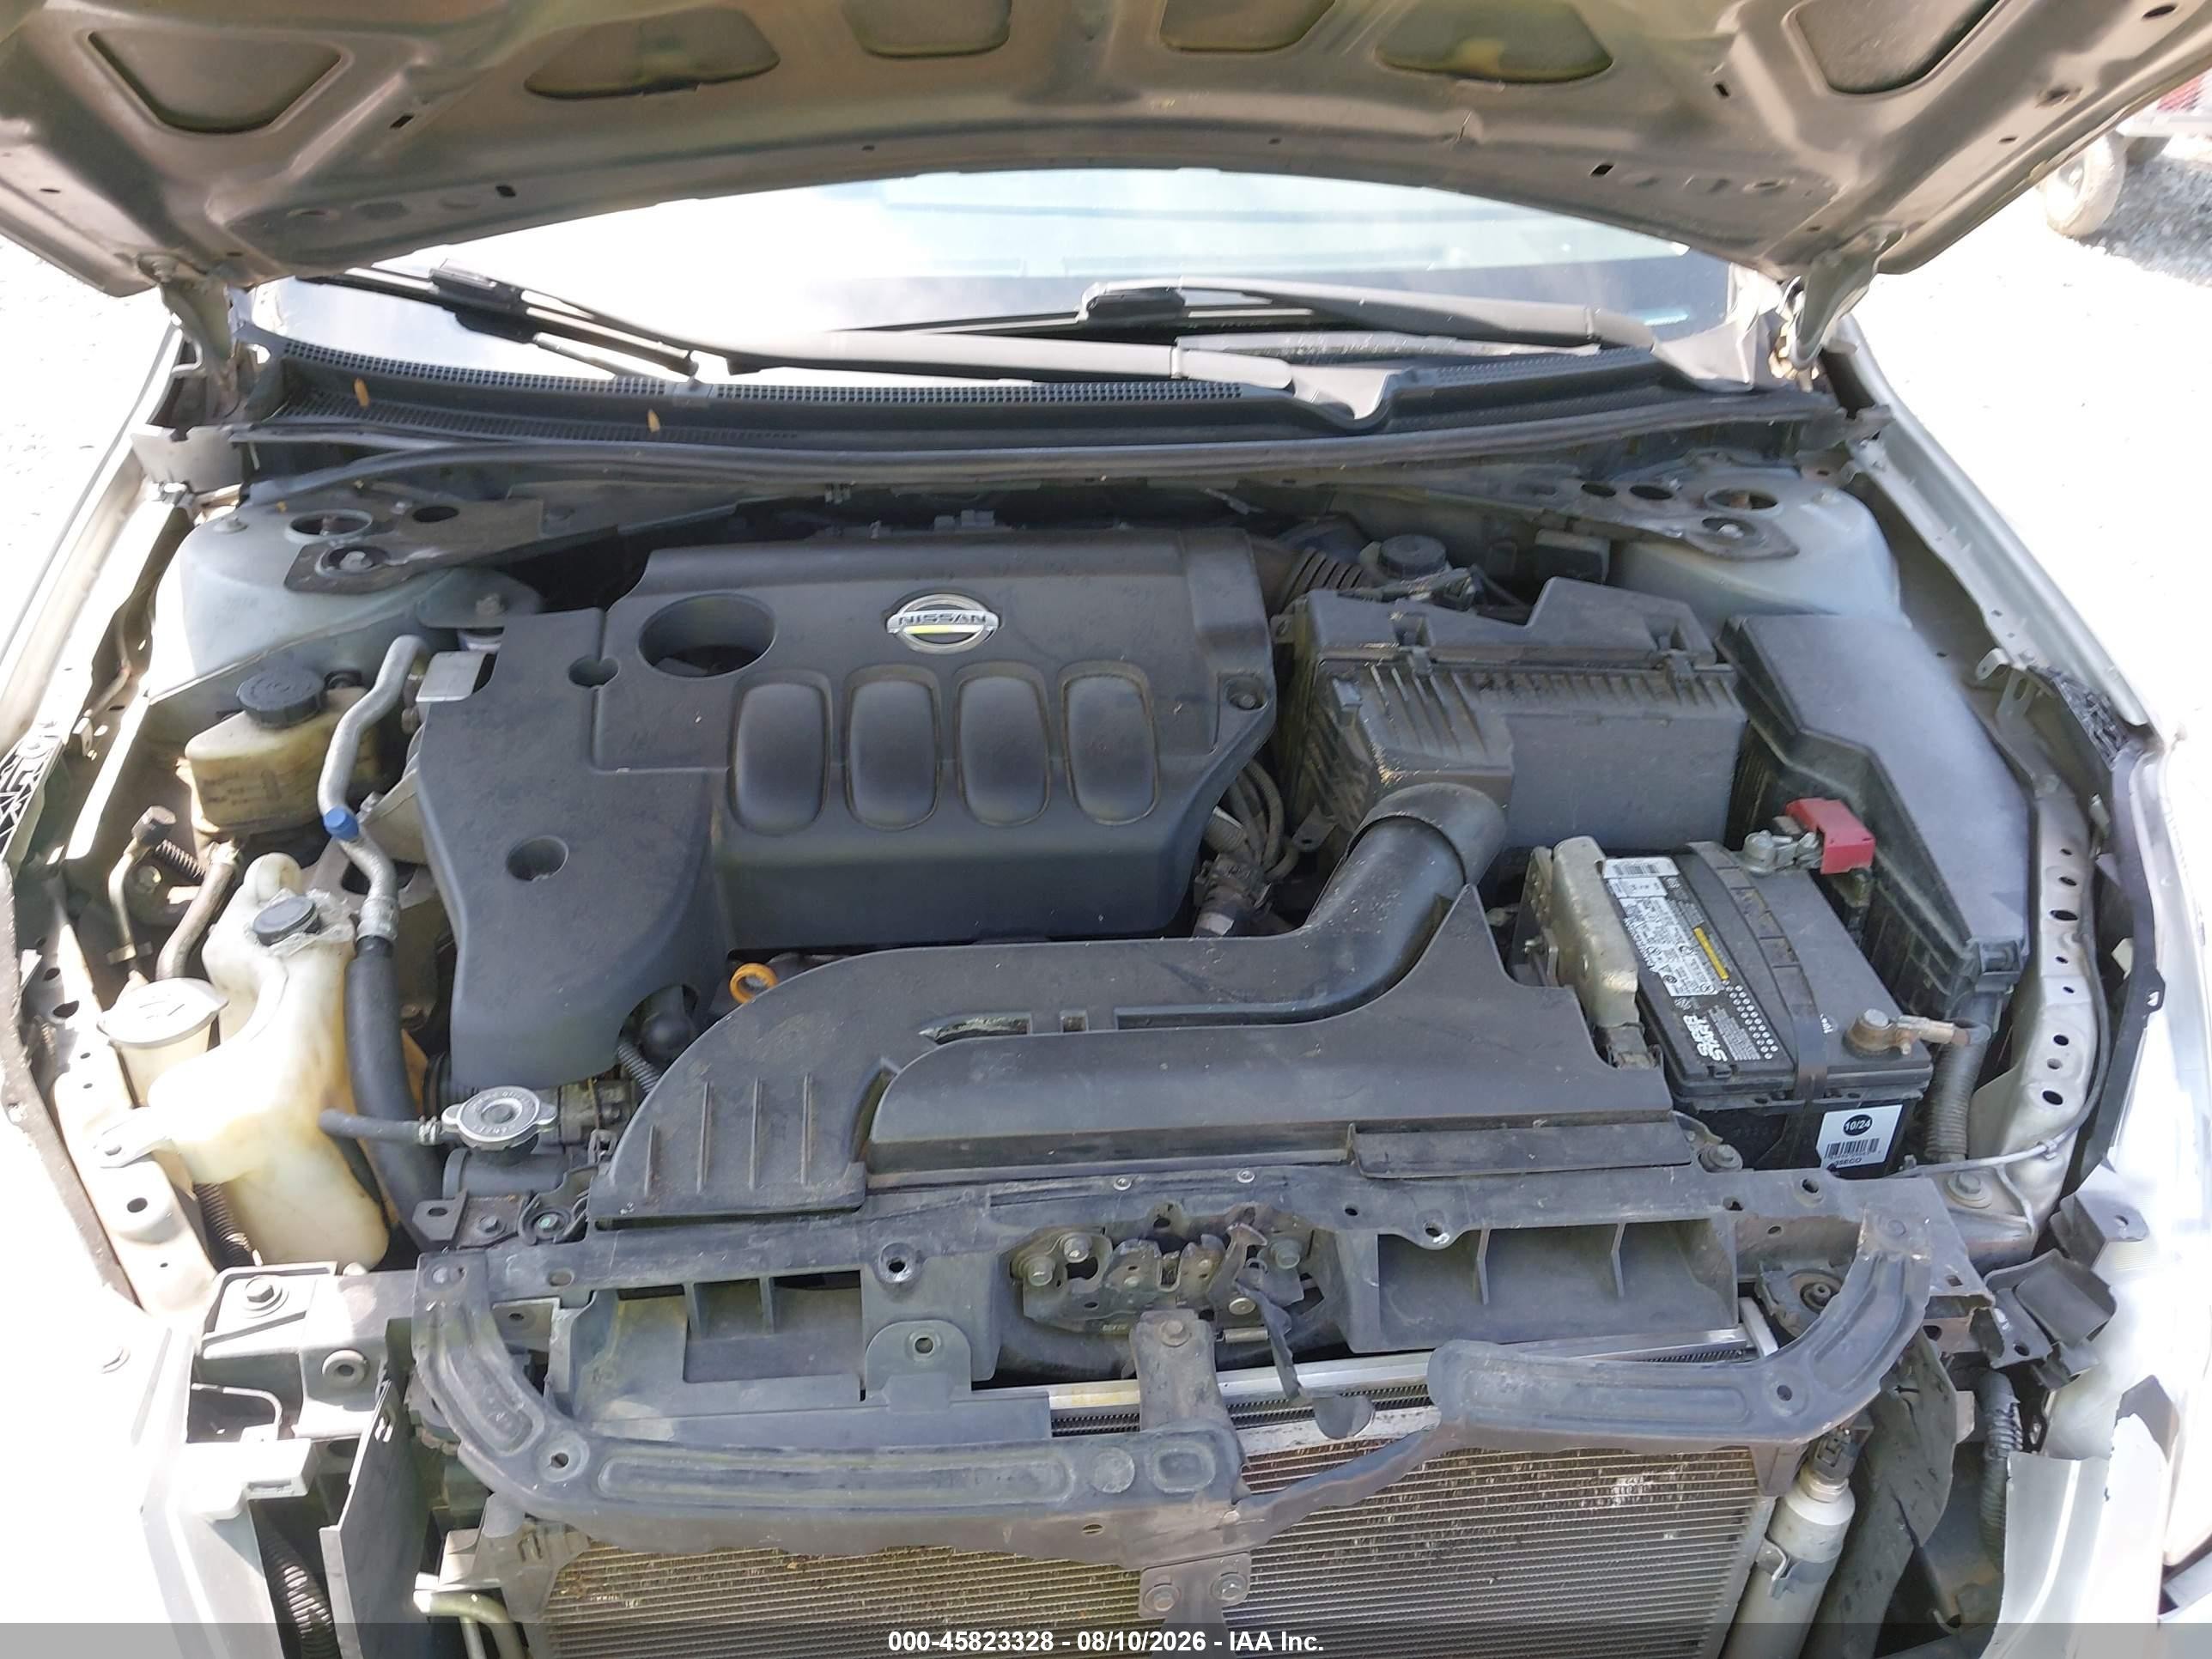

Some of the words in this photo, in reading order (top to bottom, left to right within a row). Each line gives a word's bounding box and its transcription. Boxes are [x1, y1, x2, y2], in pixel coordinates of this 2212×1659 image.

[898, 613, 986, 625] NISSAN
[1683, 1014, 1711, 1056] SUPER
[1697, 1017, 1728, 1061] START
[1844, 1119, 1870, 1131] 10/24
